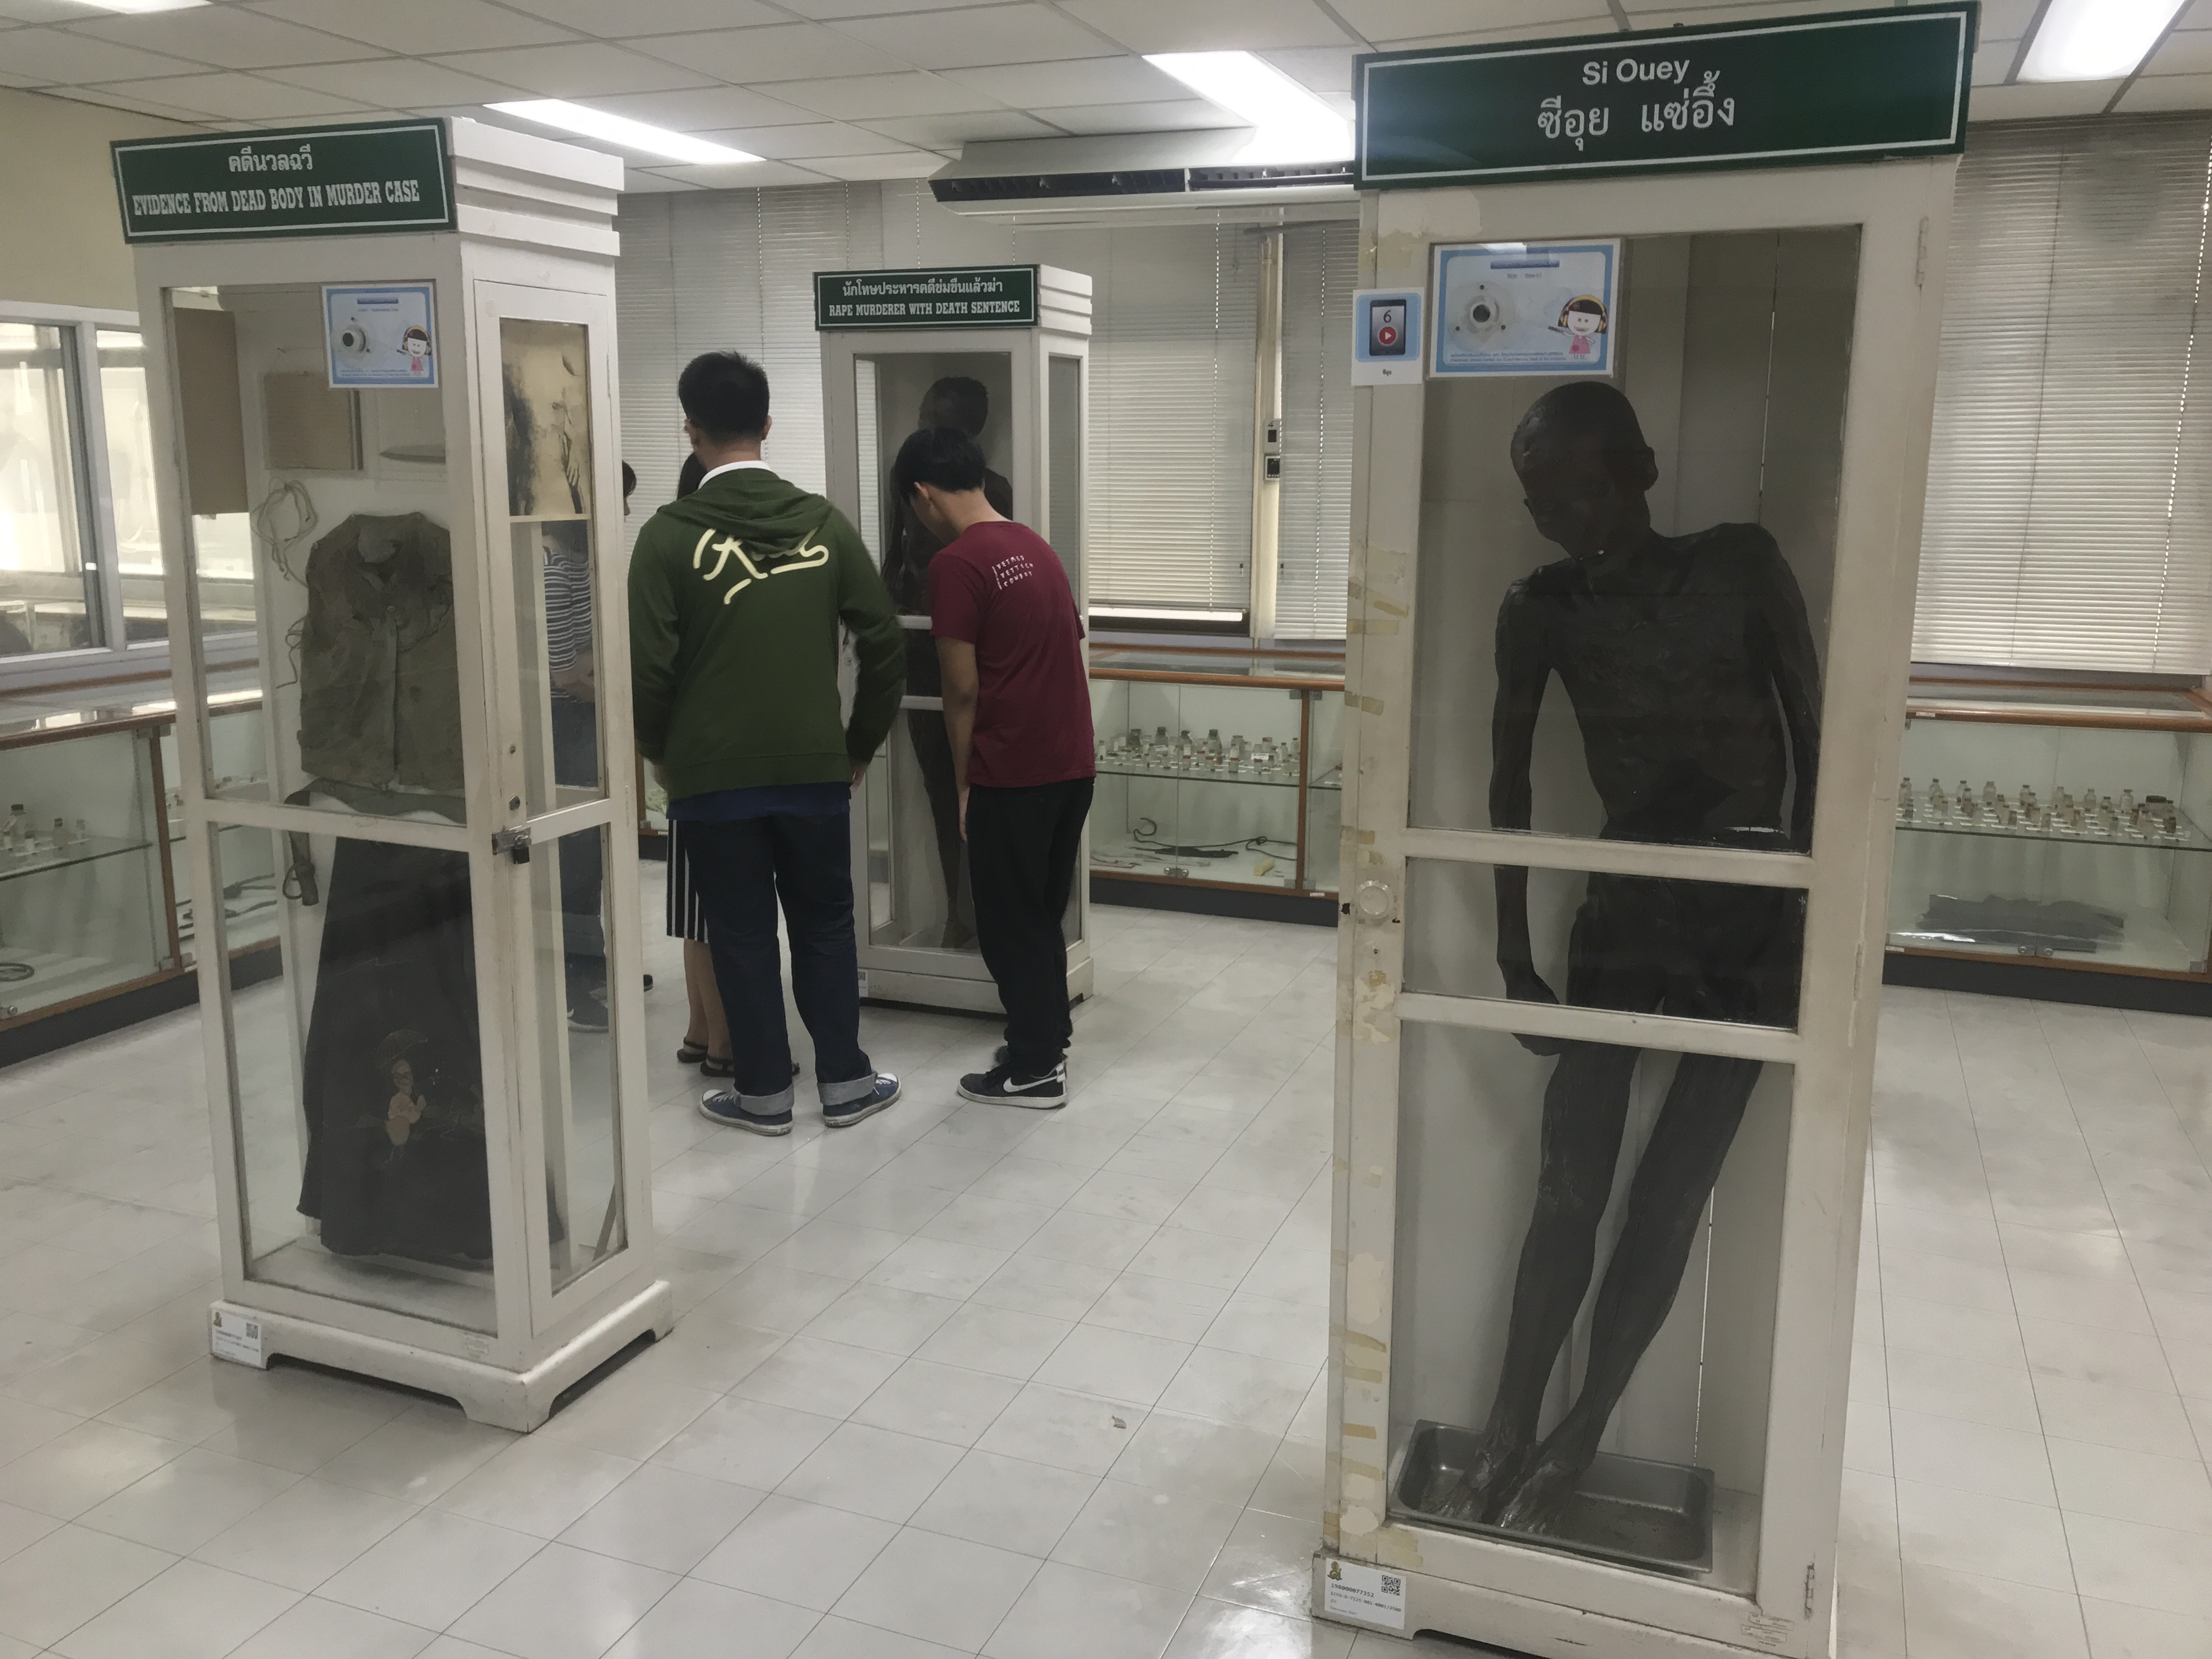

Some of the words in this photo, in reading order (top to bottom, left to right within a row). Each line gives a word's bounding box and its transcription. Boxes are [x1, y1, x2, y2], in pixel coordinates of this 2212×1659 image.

[1582, 61, 1608, 85] Si
[1616, 58, 1690, 84] Ouey
[1537, 95, 1609, 151] ซีอุย
[1641, 70, 1735, 133] แซ่อึ้ง
[228, 143, 313, 172] คดีนวลฉวี
[132, 193, 192, 216] EVIDENCE
[193, 191, 229, 213] FROM
[231, 189, 266, 212] DEAD
[269, 186, 304, 210] BODY
[308, 185, 323, 207] IN
[326, 182, 382, 205] MURDER
[385, 179, 420, 203] CASE
[829, 304, 853, 317] RAPE
[856, 303, 906, 316] MURDERER
[909, 302, 933, 315] WITH
[935, 301, 968, 314] DEATH
[970, 300, 1020, 314] SENTENCE
[1383, 309, 1392, 324] 6
[996, 555, 1025, 569] VETMED
[1000, 562, 1034, 579] VETTECH
[1003, 571, 1032, 587] COWBOY
